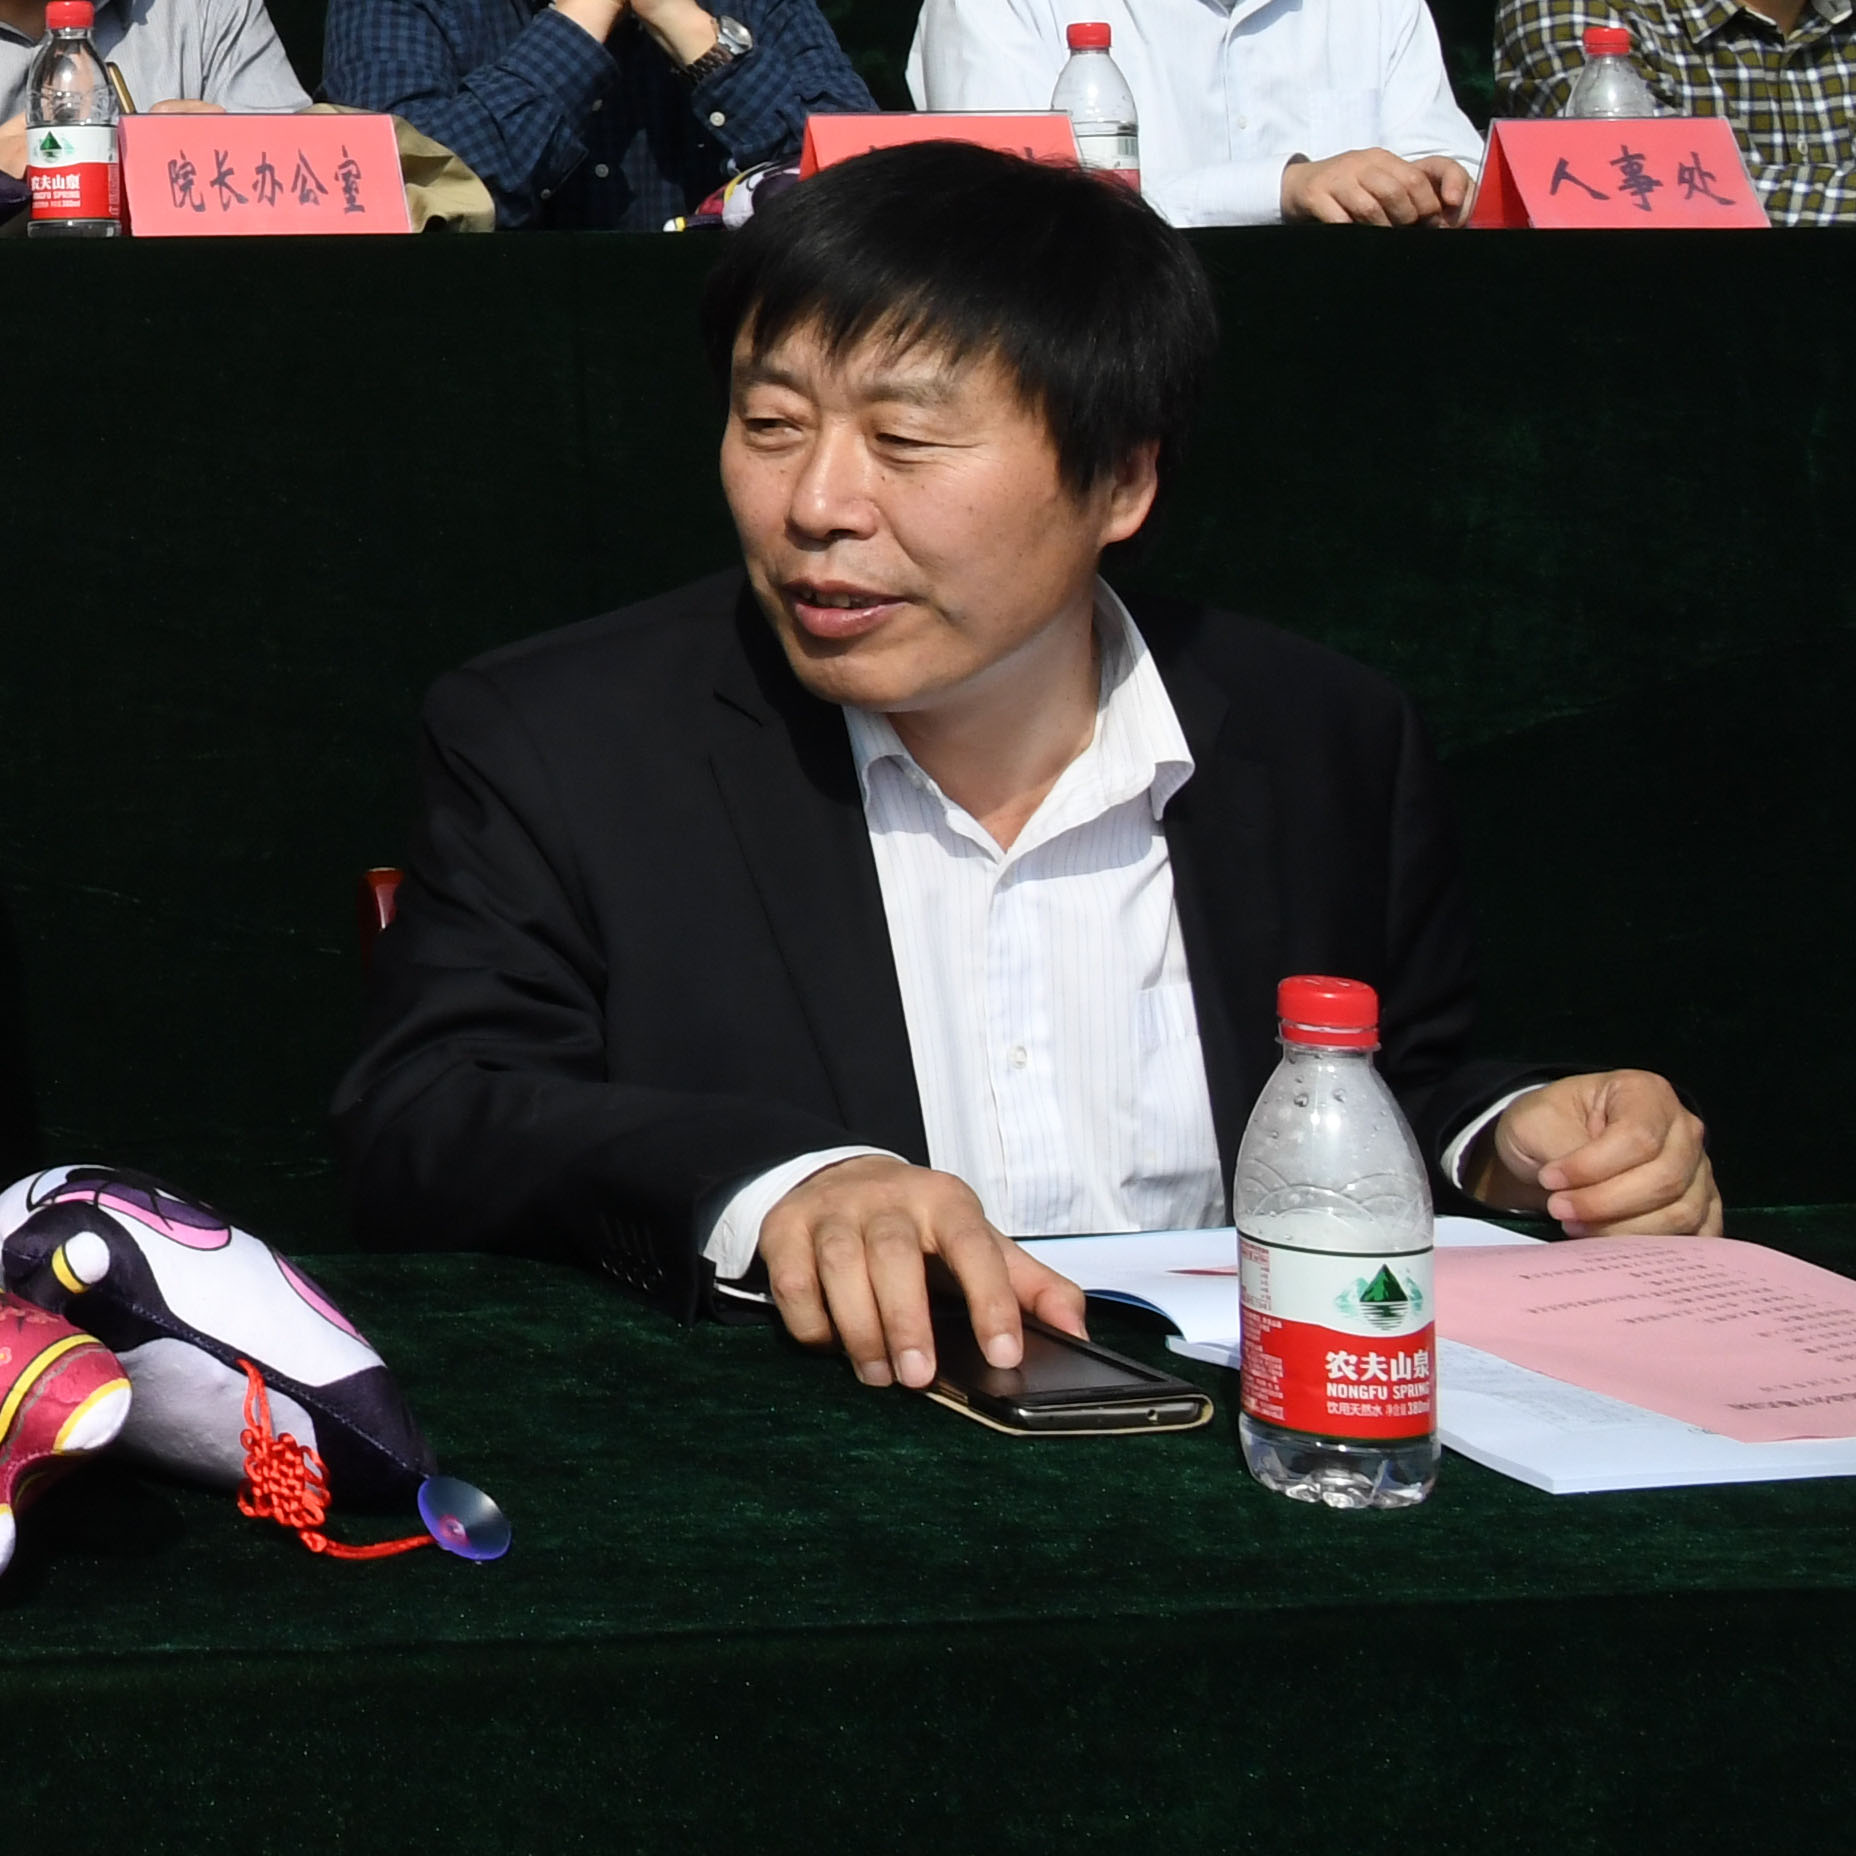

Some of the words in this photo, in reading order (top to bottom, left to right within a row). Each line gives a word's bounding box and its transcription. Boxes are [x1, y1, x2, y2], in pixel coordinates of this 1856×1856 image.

[168, 145, 366, 213] 院长办公室
[1550, 144, 1736, 212] 人事处
[1325, 1350, 1430, 1382] 农夫山泉
[1326, 1382, 1388, 1400] NONGFU
[1392, 1382, 1430, 1399] SPRING
